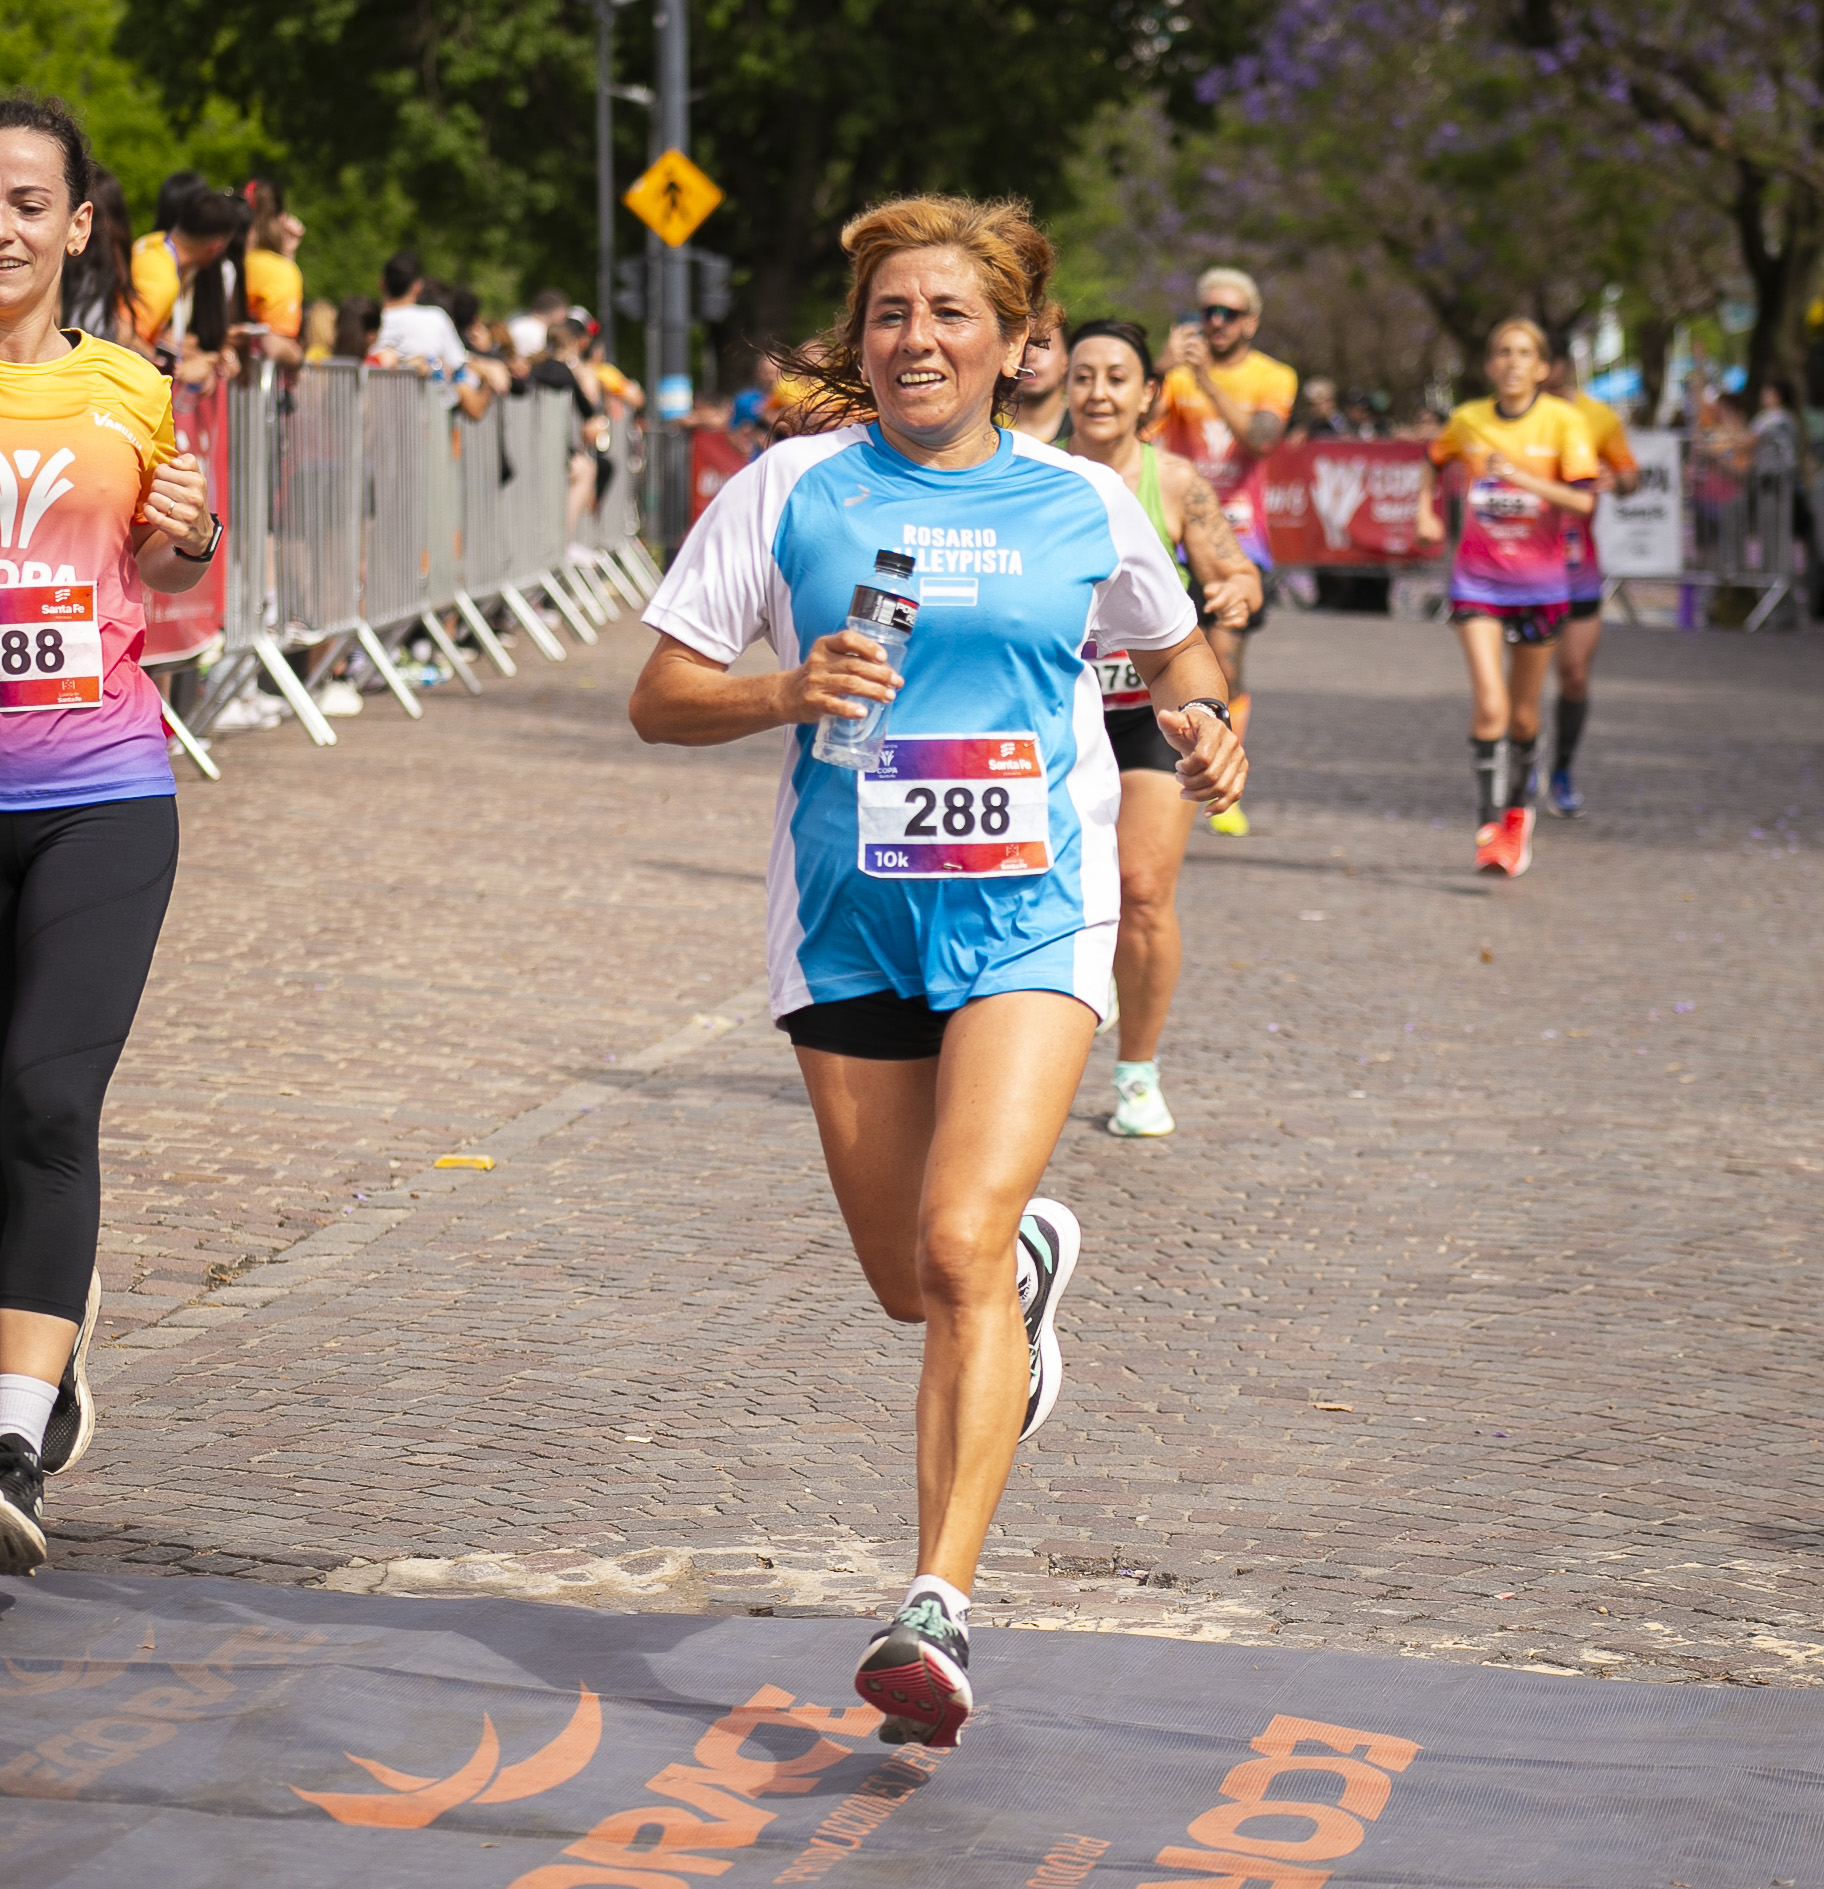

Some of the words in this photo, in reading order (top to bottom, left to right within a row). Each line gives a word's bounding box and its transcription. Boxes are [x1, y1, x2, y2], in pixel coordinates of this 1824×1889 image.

[902, 524, 997, 548] ROSARIO
[41, 604, 72, 614] Santa
[73, 603, 85, 614] Fe
[1, 628, 65, 675] 88
[1092, 664, 1141, 690] 78
[988, 759, 1018, 770] Santa
[1019, 759, 1032, 770] Fe
[904, 786, 1010, 837] 288
[874, 851, 909, 868] 10k
